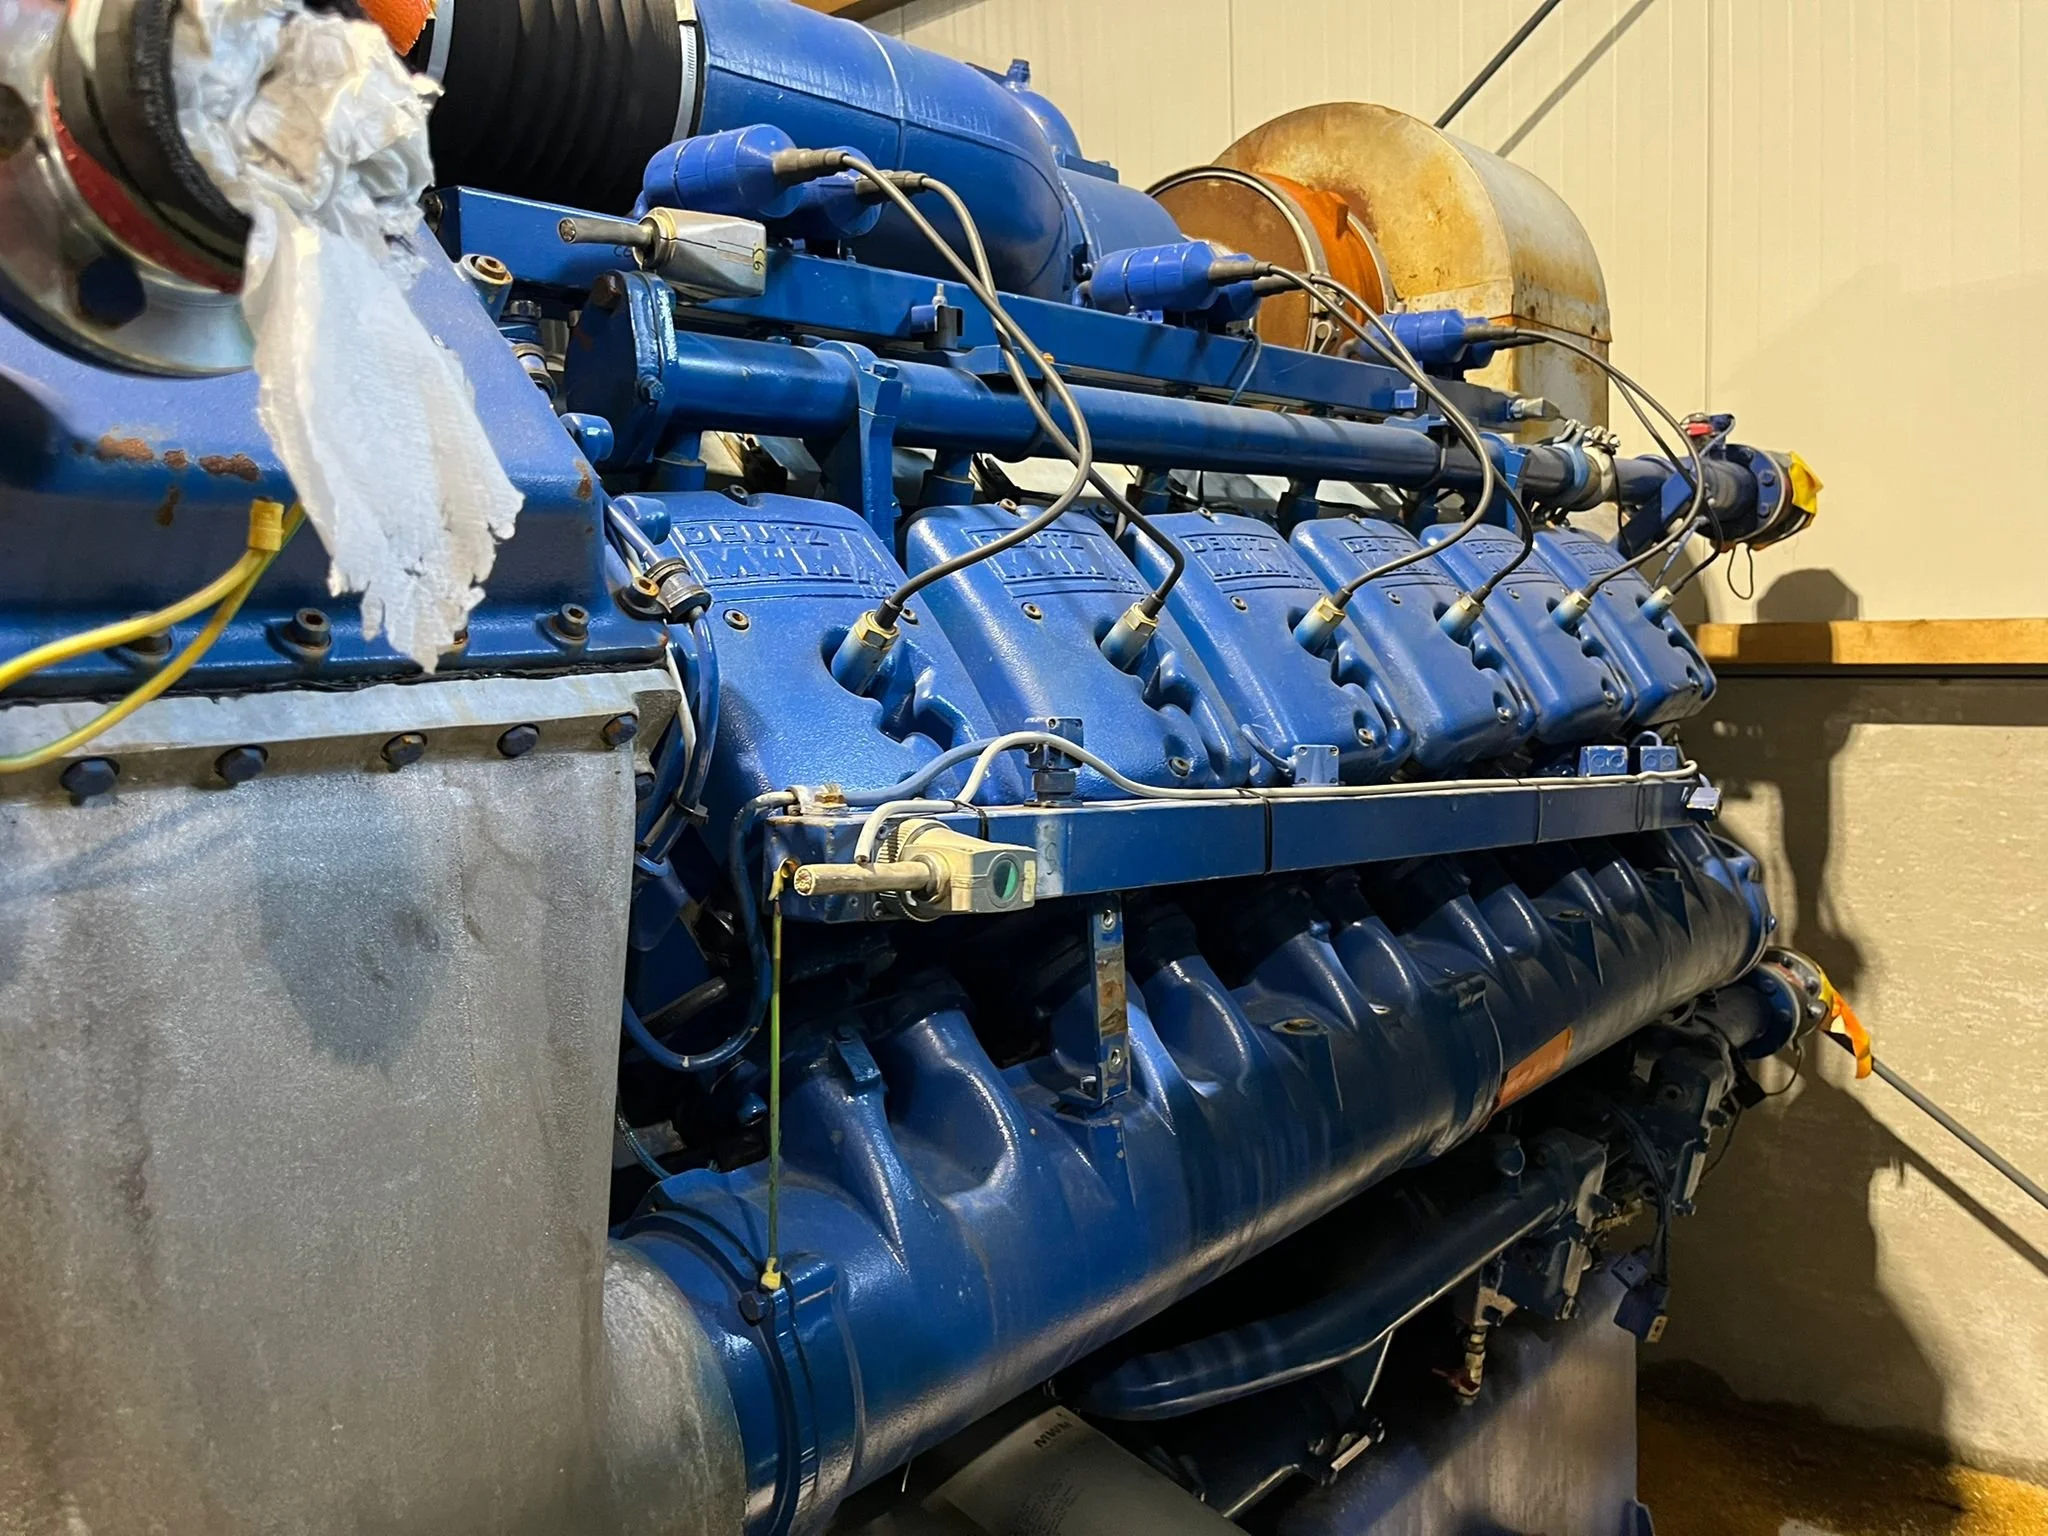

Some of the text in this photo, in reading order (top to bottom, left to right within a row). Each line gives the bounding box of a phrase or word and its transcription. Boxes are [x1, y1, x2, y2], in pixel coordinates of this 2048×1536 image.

[673, 525, 829, 546] DEUTZ
[1183, 537, 1269, 553] DEUTZ
[1034, 1421, 1073, 1448] MWM
